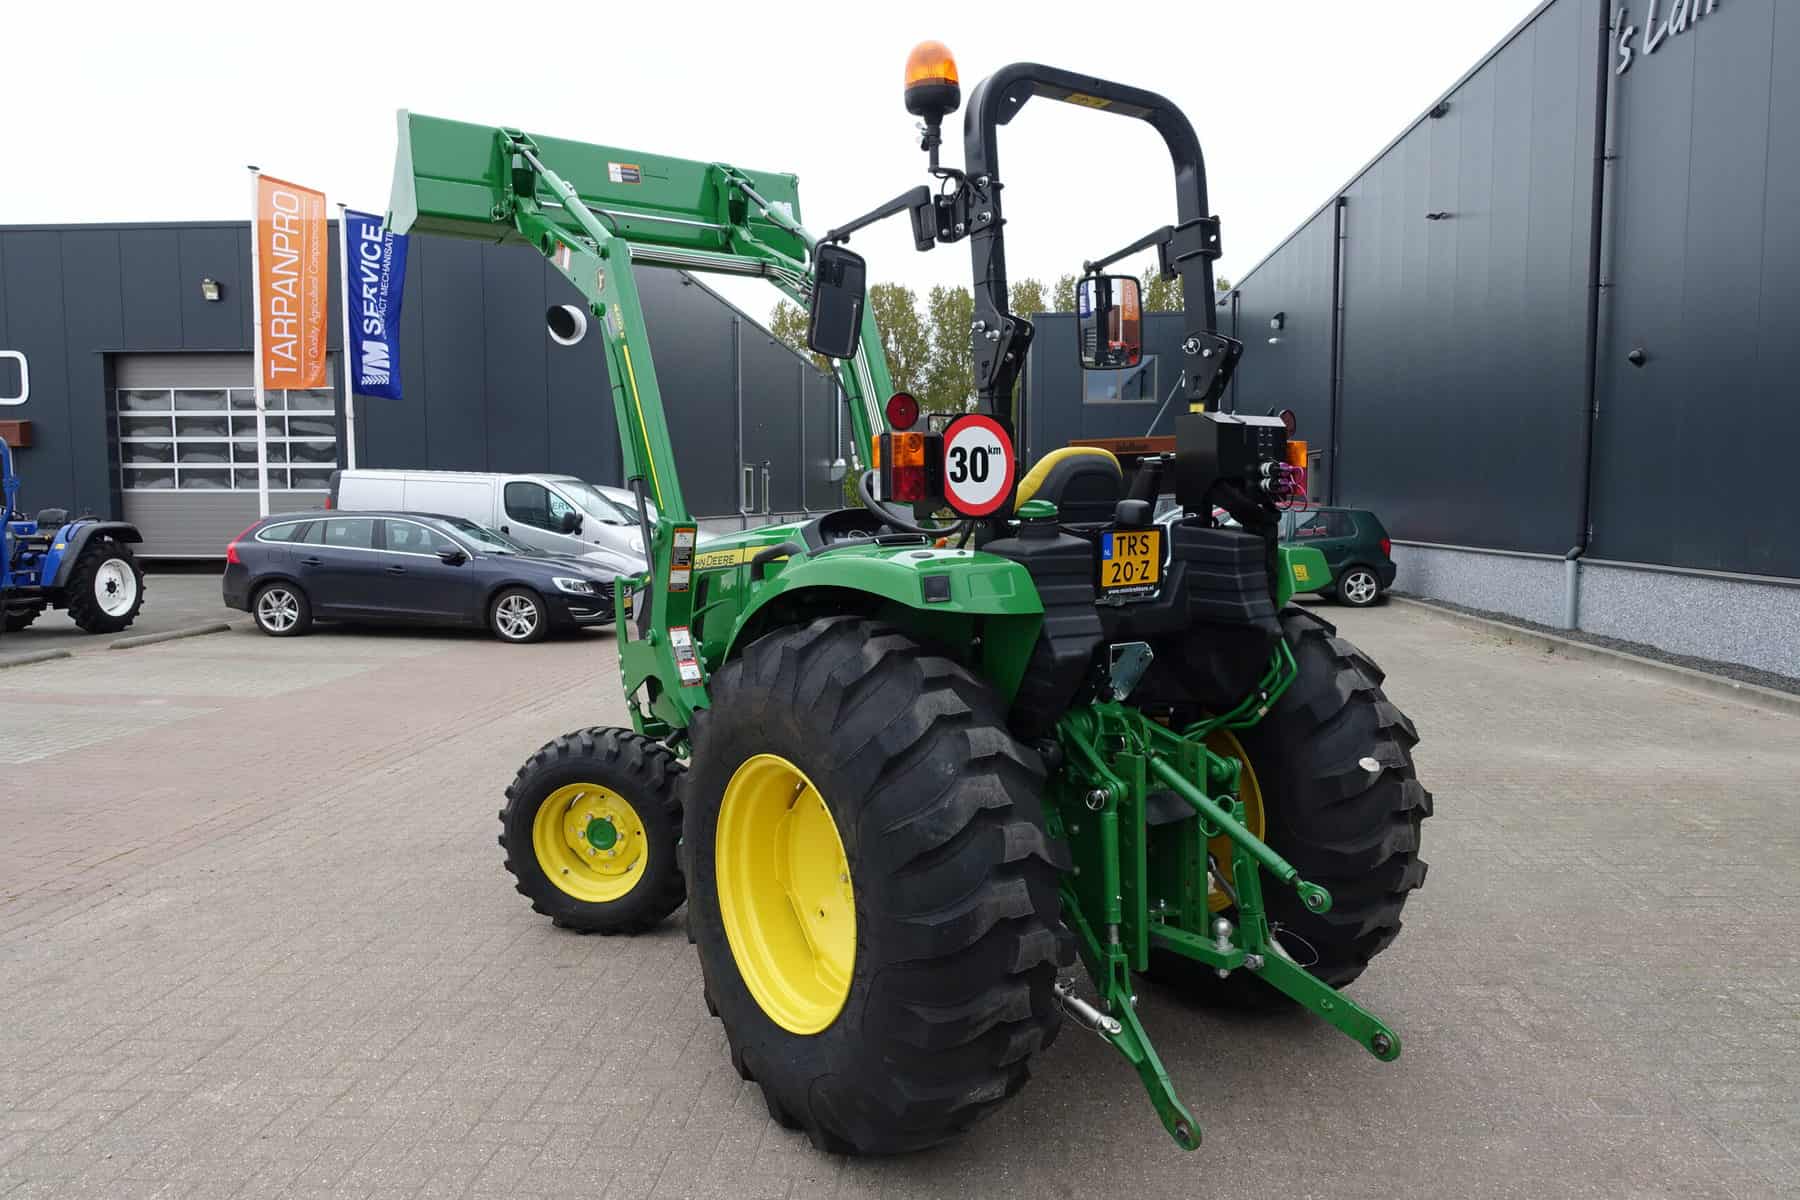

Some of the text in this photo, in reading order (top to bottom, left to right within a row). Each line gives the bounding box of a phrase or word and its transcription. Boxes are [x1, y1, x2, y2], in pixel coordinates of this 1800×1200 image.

[271, 190, 300, 379] TARPANPRO
[308, 275, 321, 324] Agricultural
[360, 223, 383, 336] SERVICE
[309, 326, 321, 358] Quality
[949, 443, 1001, 483] 30 km
[1116, 534, 1149, 556] TRS
